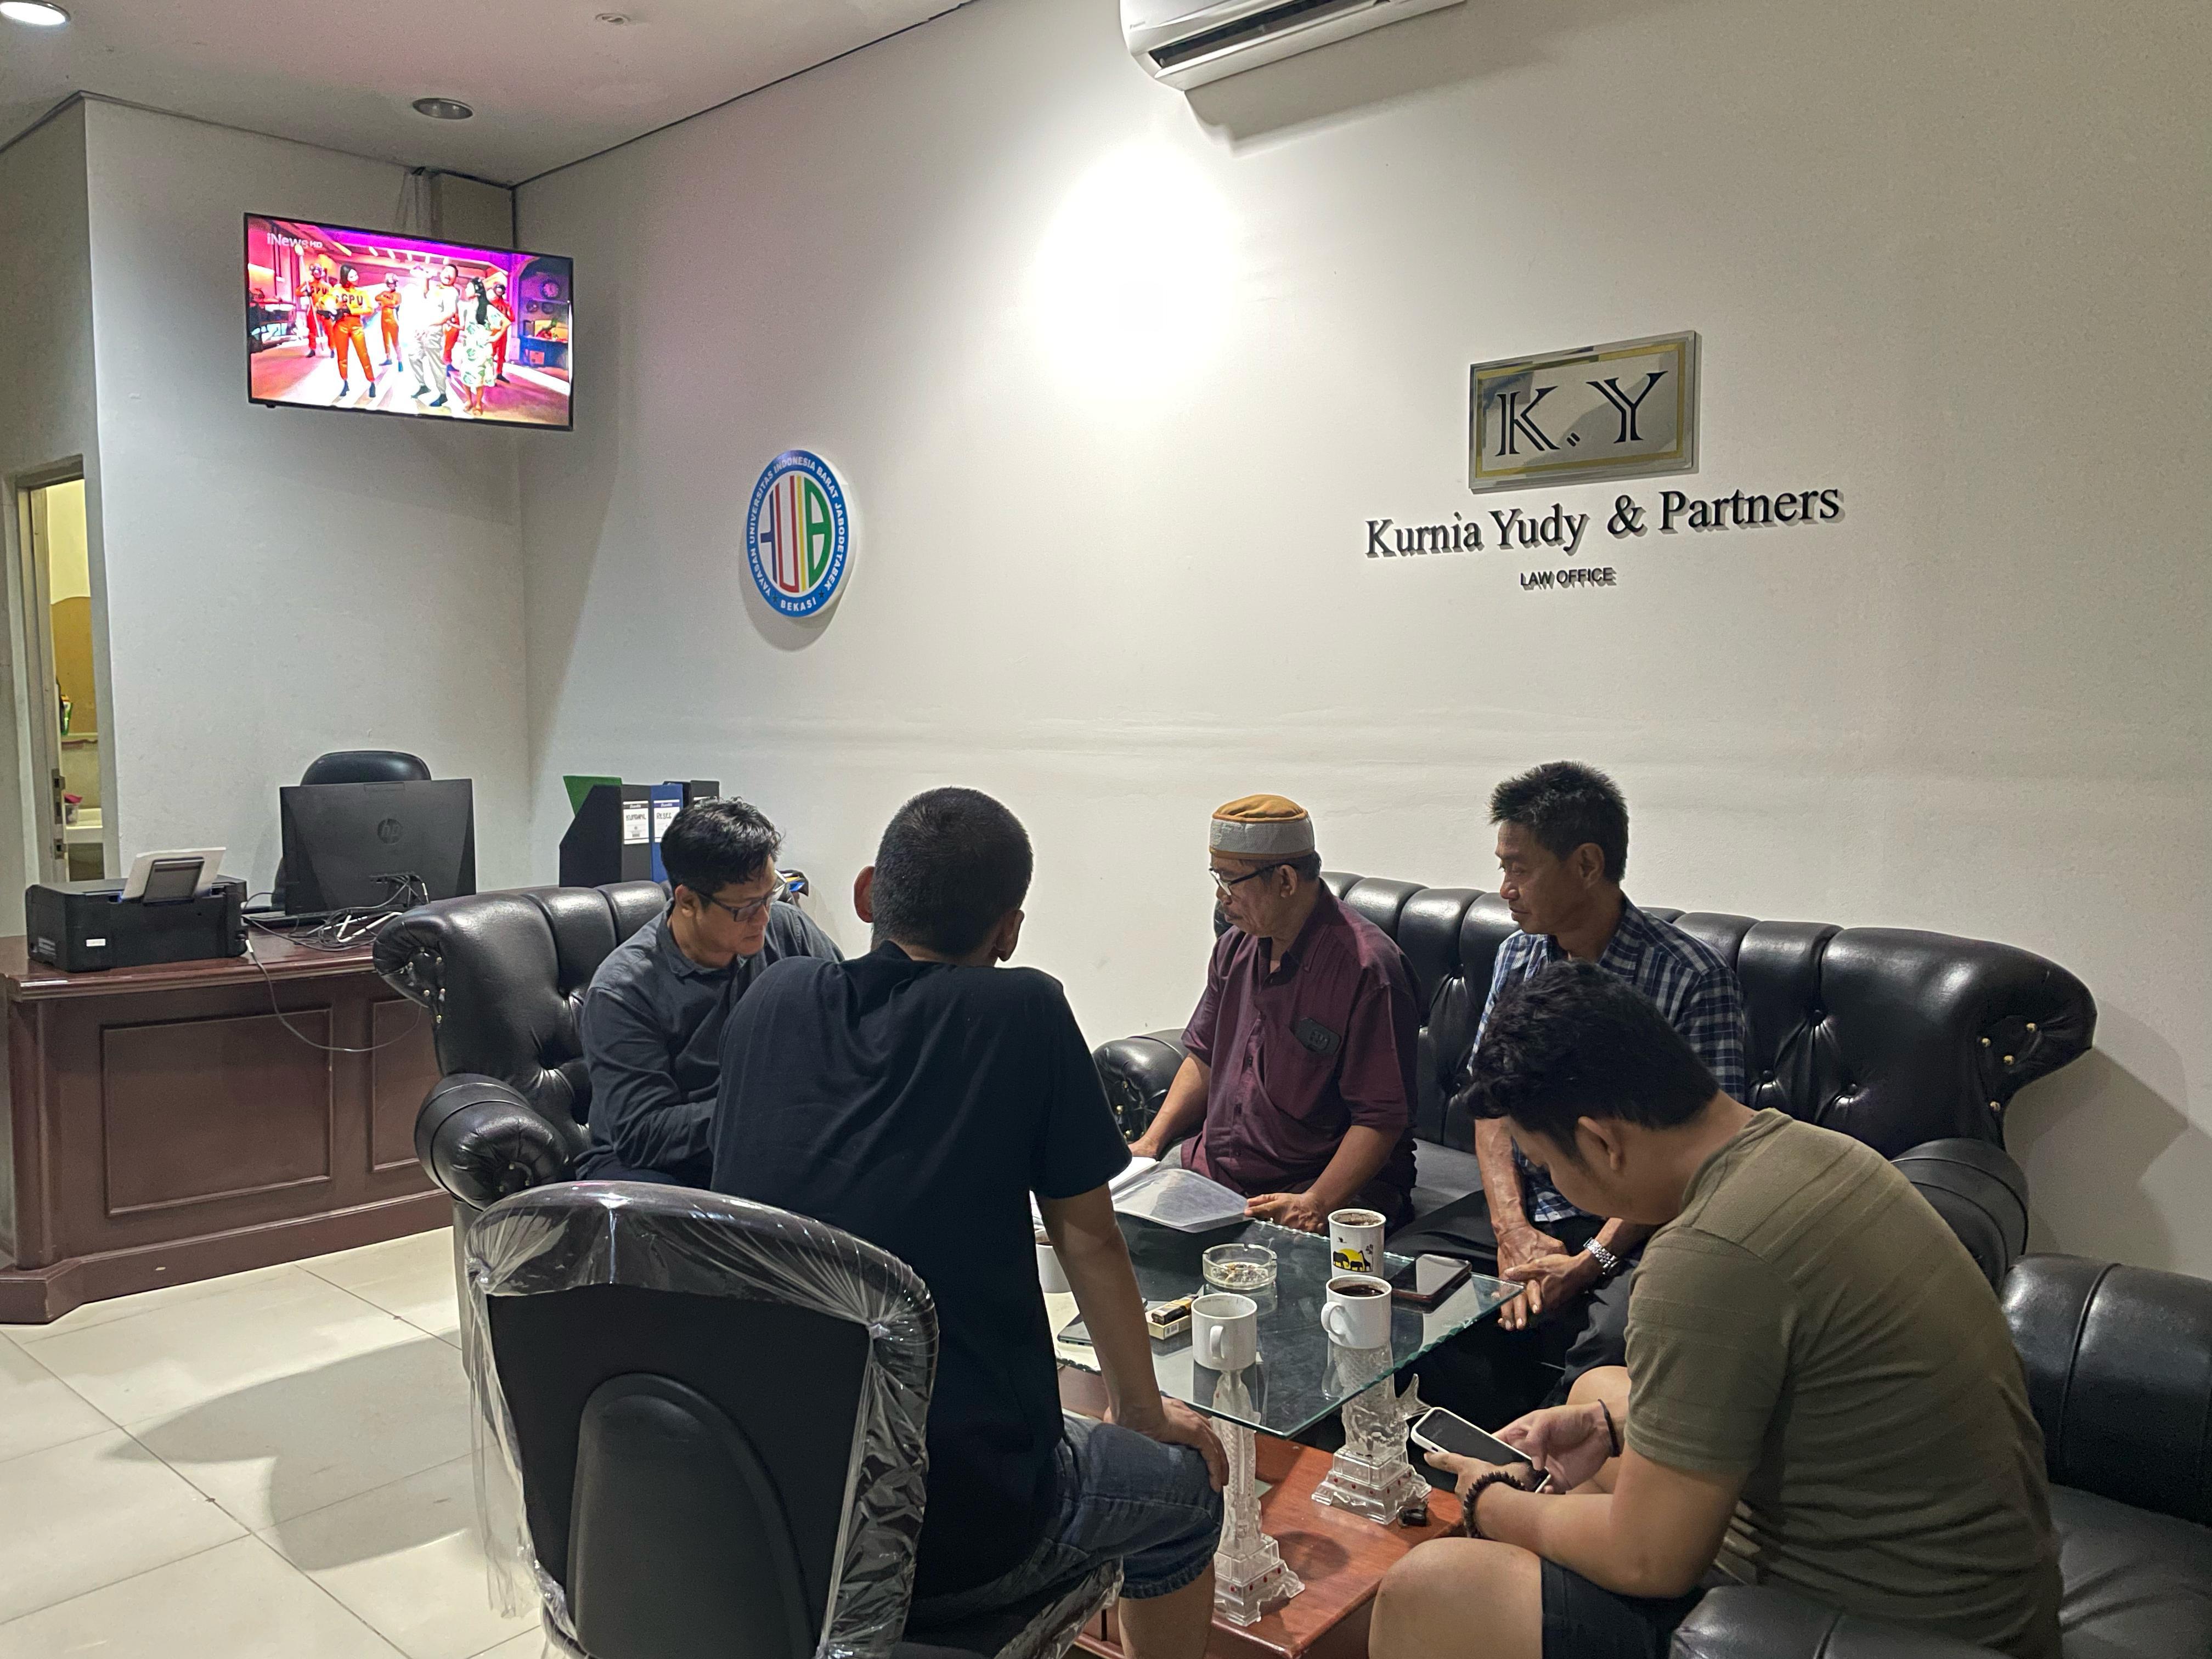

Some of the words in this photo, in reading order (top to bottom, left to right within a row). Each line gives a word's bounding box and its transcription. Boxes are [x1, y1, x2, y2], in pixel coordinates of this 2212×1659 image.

[267, 233, 308, 248] iNews
[341, 293, 363, 306] GPU
[774, 456, 816, 474] INDONESIA
[816, 466, 839, 499] BARAT
[749, 470, 774, 544] UNIVERSITAS
[1365, 511, 1483, 555] Kurnia
[1488, 503, 1587, 554] Yudy
[1607, 495, 1645, 535] &
[1658, 488, 1839, 531] Partners
[824, 502, 845, 591] JABODETABEK
[751, 548, 771, 597] YAYASAN
[1521, 571, 1554, 586] LAW
[1556, 567, 1614, 584] OFFICE
[780, 597, 816, 611] BEKASI
